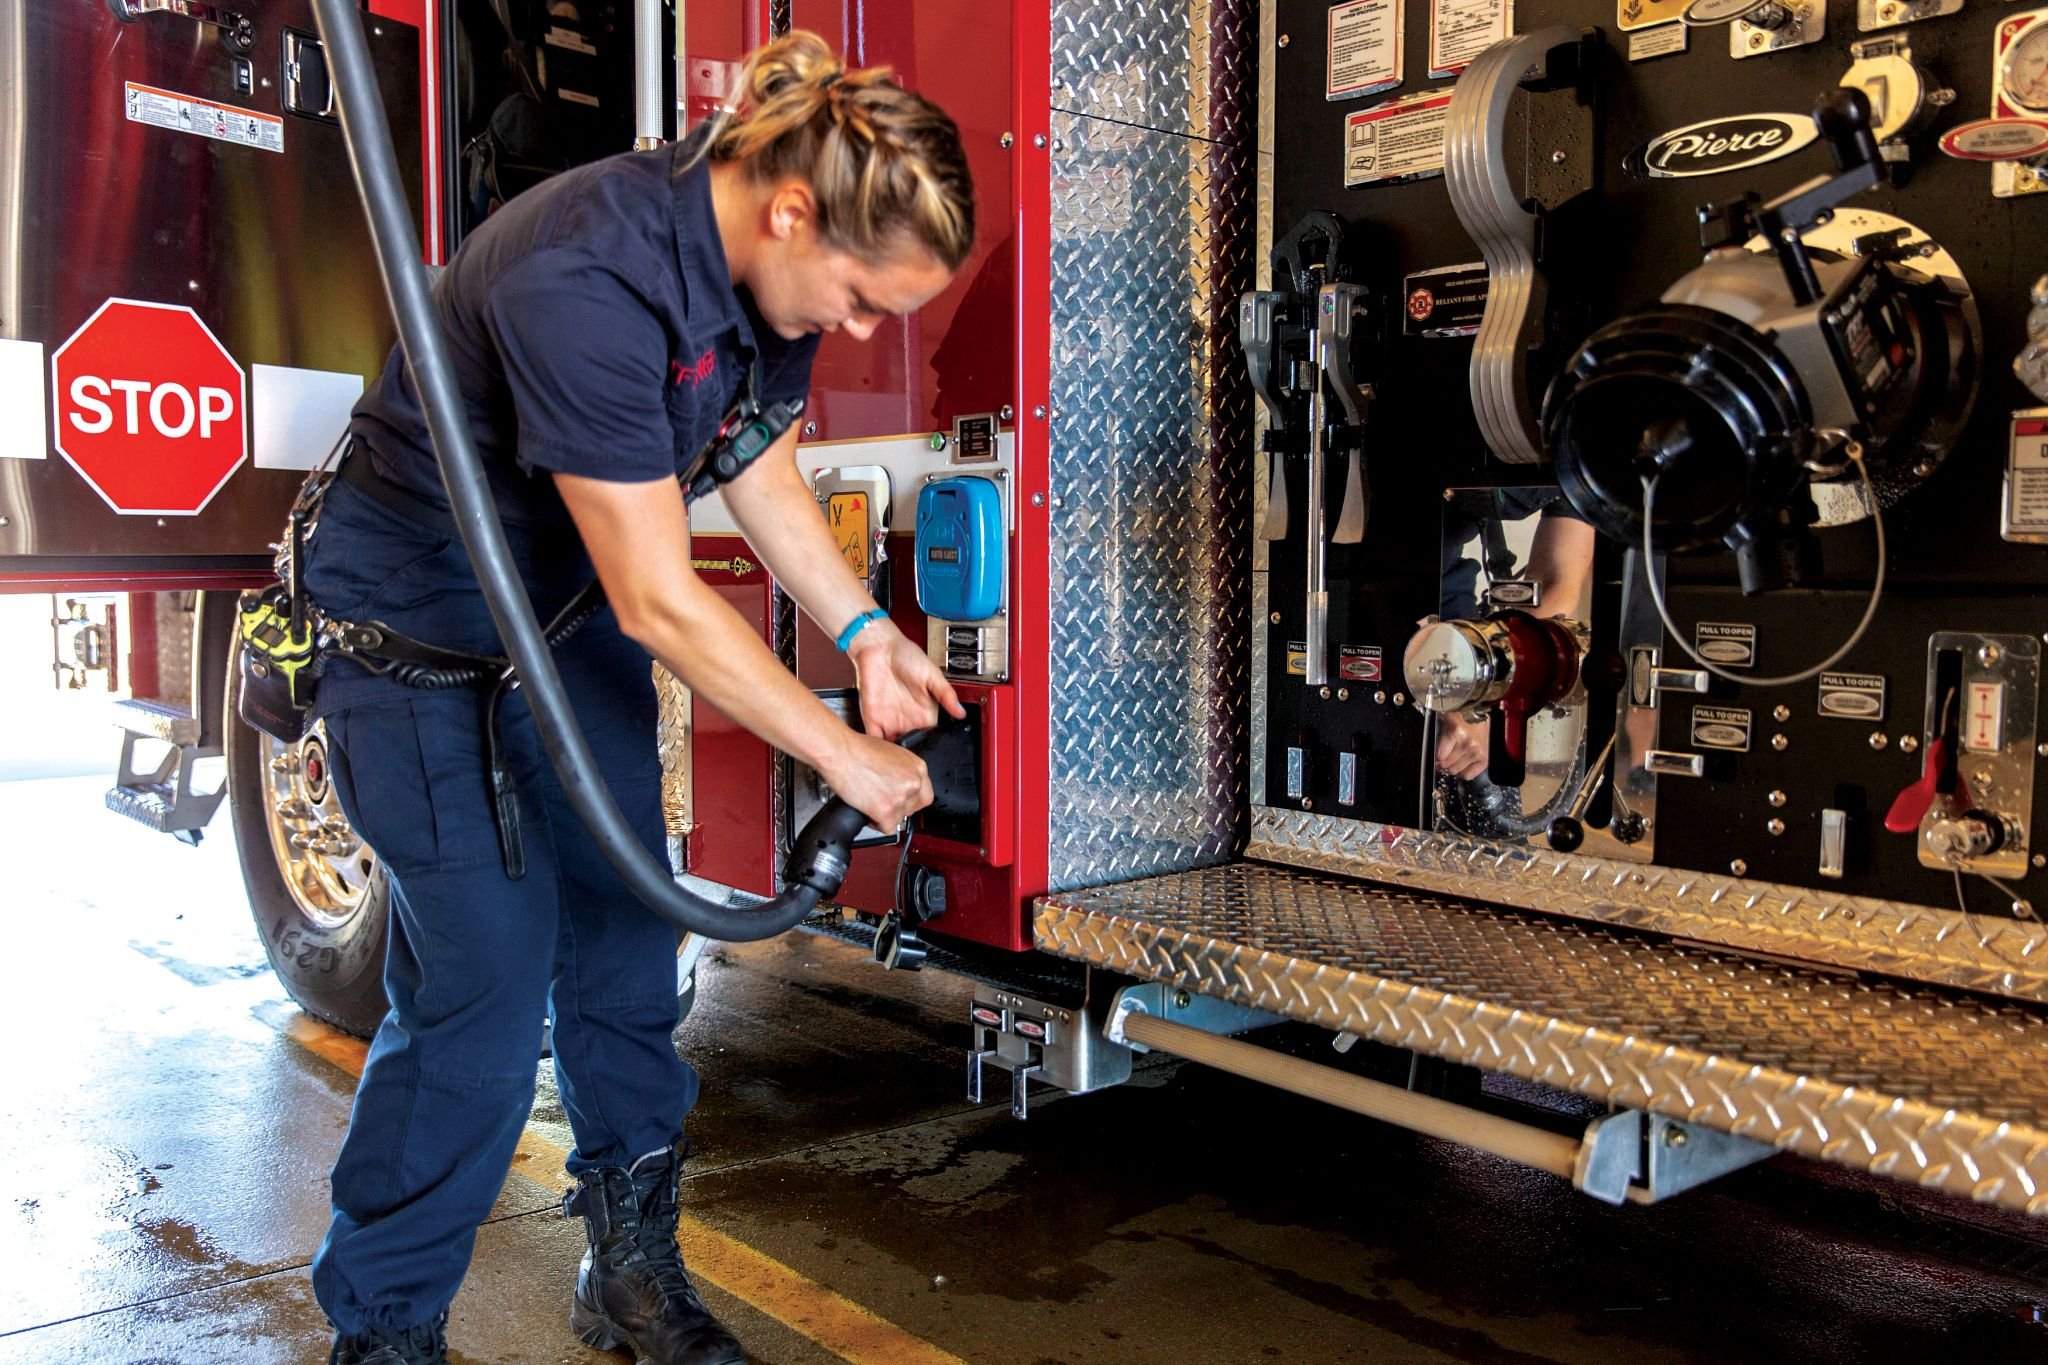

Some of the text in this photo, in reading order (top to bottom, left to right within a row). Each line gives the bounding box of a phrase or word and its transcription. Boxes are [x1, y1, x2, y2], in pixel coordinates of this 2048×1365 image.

[1657, 127, 1783, 168] Pierce
[1435, 296, 1461, 306] RELIANT
[1462, 295, 1476, 303] FIRE
[69, 374, 234, 440] STOP
[1732, 628, 1752, 636] OPEN
[1823, 676, 1882, 688] PULL TO OPEN
[1696, 710, 1748, 721] PULL TO OPEN
[272, 918, 338, 975] G291
